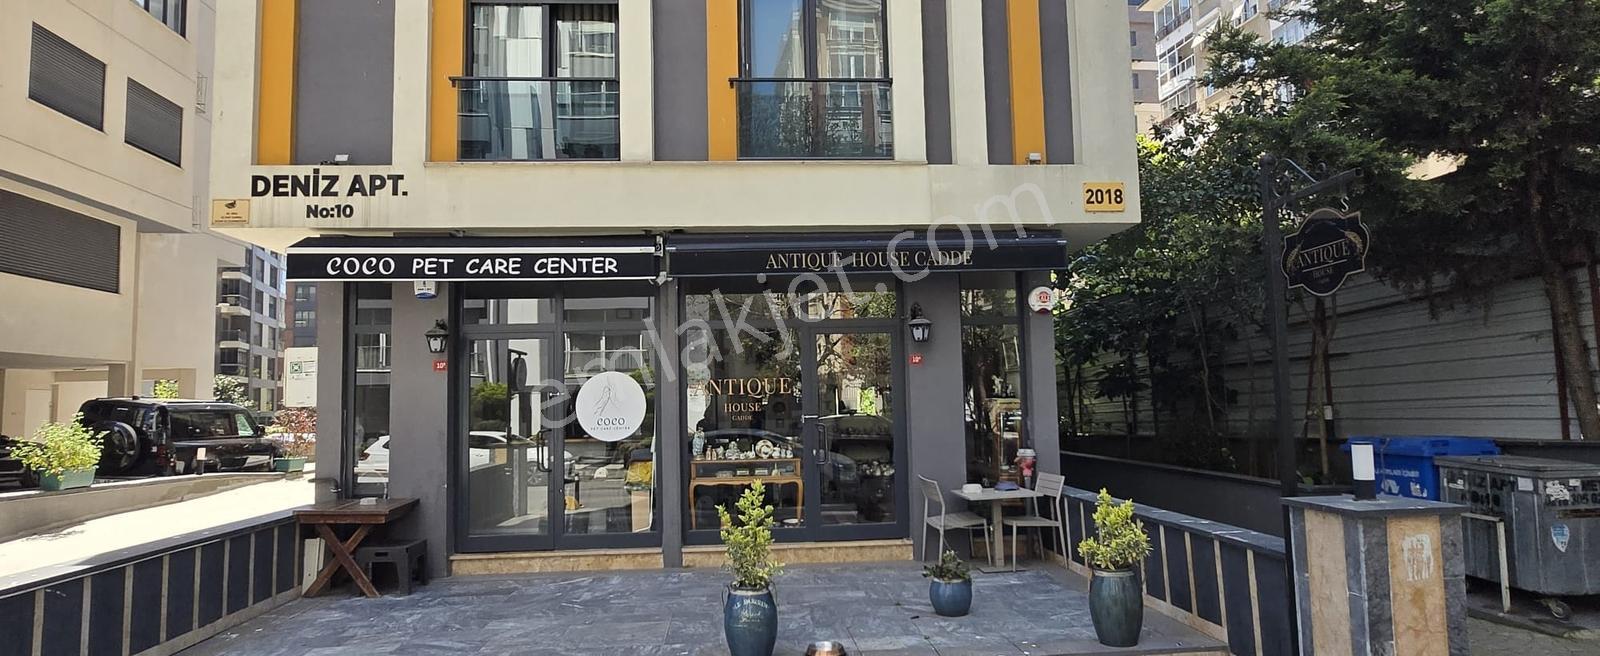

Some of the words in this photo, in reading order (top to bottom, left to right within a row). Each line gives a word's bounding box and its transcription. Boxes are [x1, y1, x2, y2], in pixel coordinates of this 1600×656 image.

[251, 168, 340, 197] DENİZ
[347, 174, 408, 197] APT.
[1085, 188, 1124, 205] 2018
[306, 204, 354, 219] No:10
[326, 257, 396, 276] COCO
[412, 257, 454, 275] PET
[465, 257, 522, 274] CARE
[533, 257, 619, 274] CENTER
[765, 251, 843, 271] ANTIQUE
[852, 250, 910, 267] HOUSE
[914, 250, 973, 267] CADDE
[693, 377, 792, 398] ANTIQUE
[724, 402, 762, 413] HOUSE
